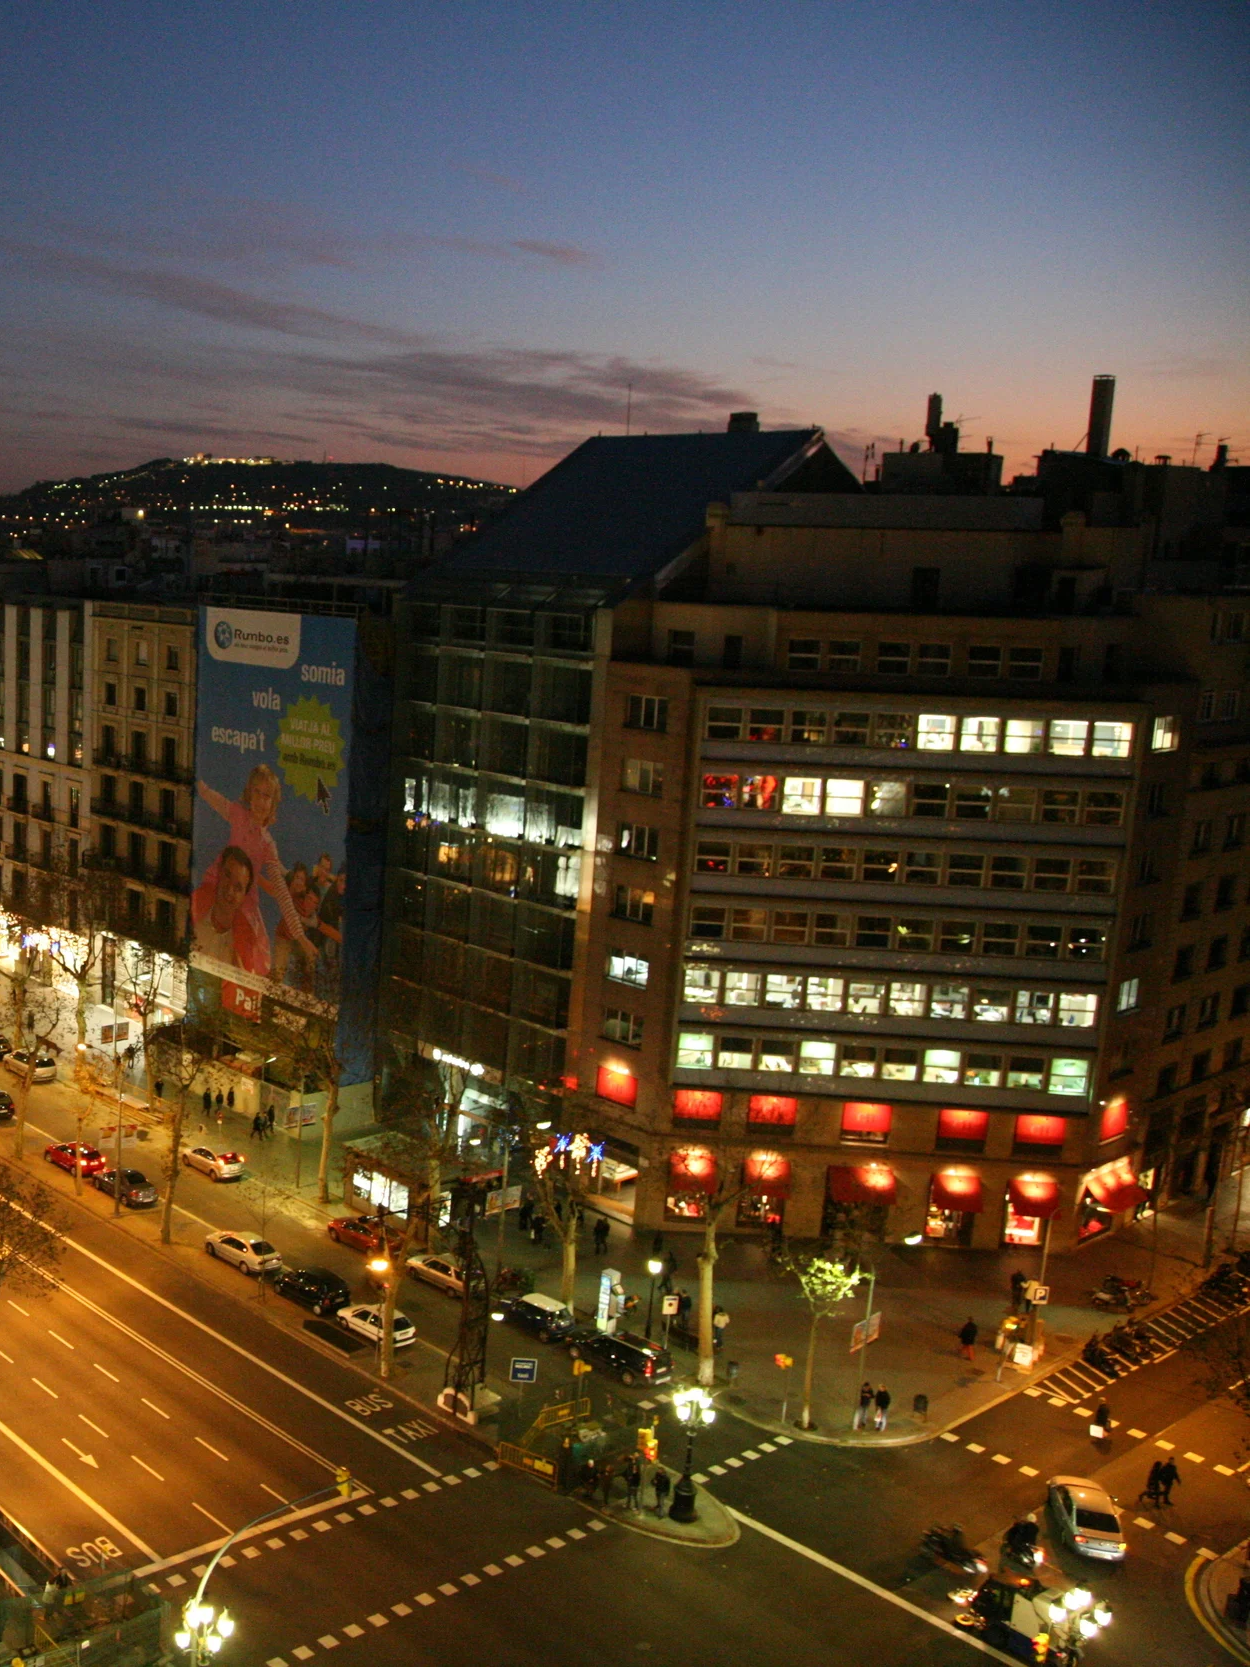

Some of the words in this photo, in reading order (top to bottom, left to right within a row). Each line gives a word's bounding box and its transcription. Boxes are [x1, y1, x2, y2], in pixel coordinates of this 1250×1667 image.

[234, 629, 290, 645] Rumbo.es
[301, 662, 346, 686] somia
[252, 687, 281, 711] vola
[211, 725, 266, 754] escapa't
[1035, 1289, 1046, 1300] P
[345, 1394, 393, 1416] BUS
[382, 1419, 439, 1443] TAXI
[65, 1535, 124, 1568] BUS
